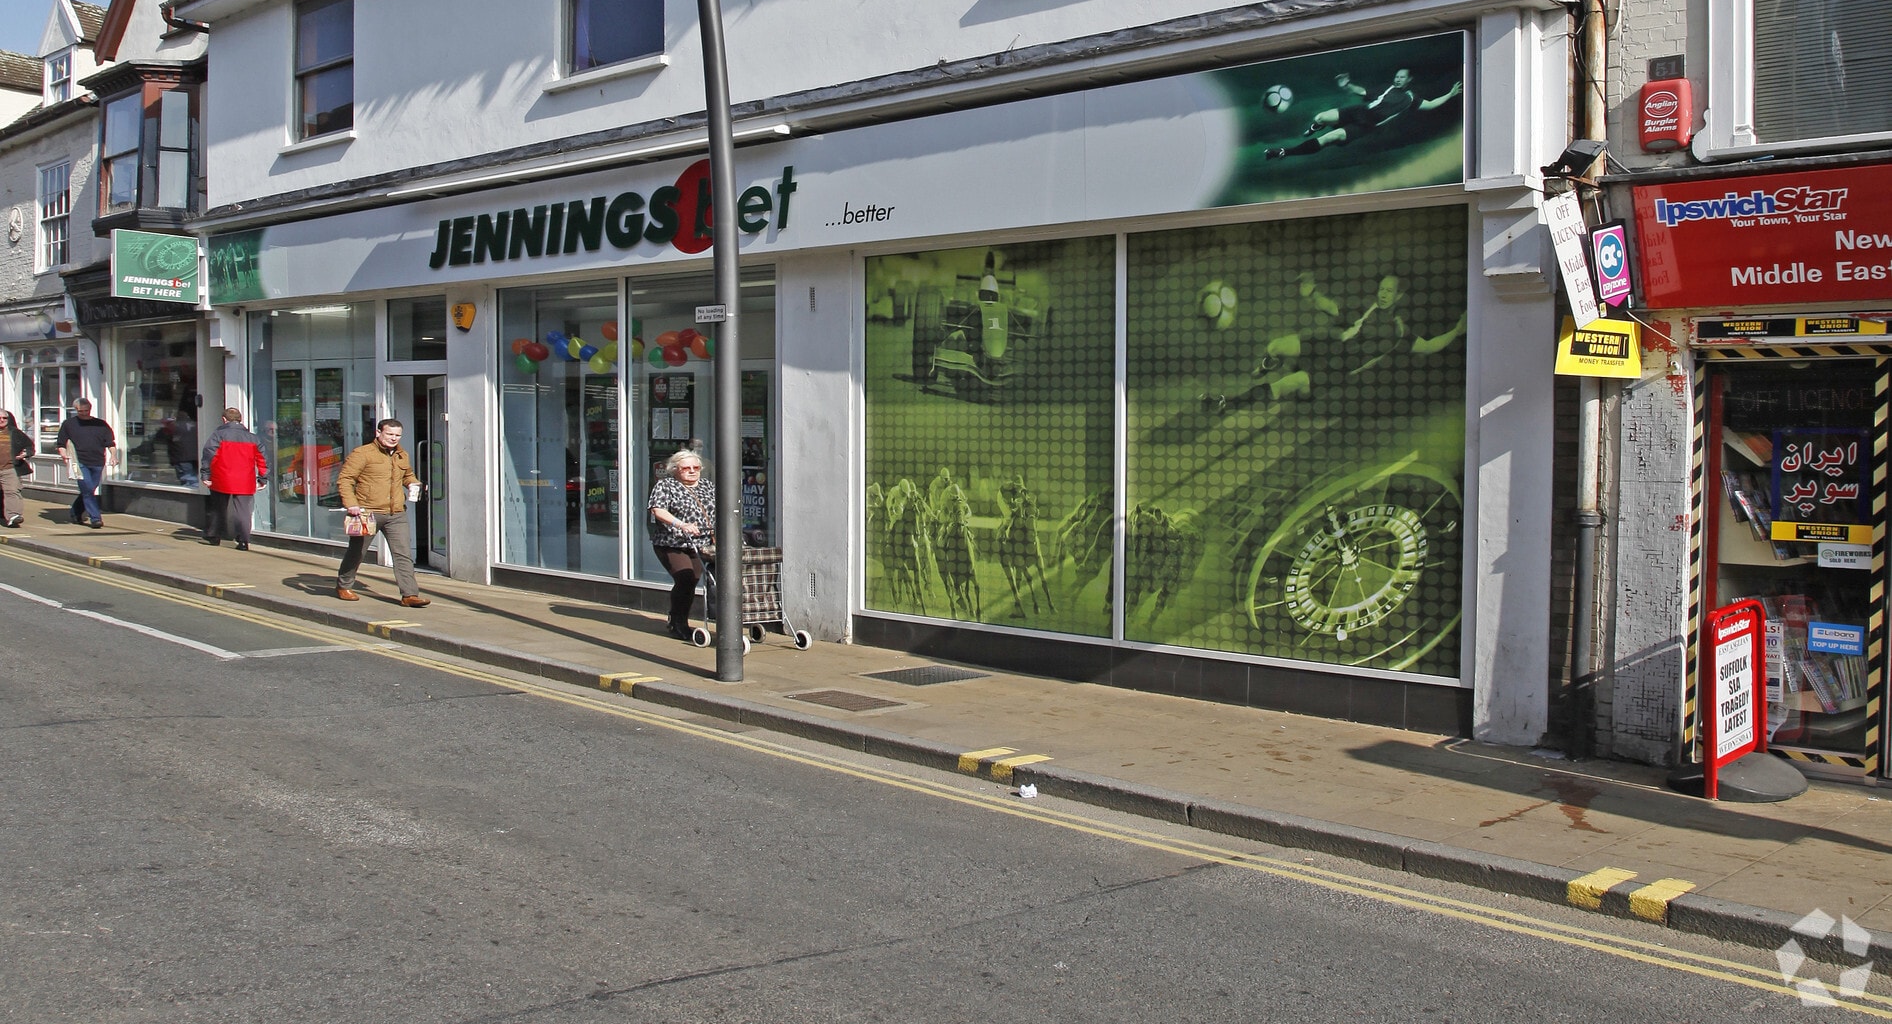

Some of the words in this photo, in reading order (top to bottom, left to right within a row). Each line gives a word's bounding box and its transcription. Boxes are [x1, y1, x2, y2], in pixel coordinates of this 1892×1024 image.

[1655, 61, 1676, 77] 51
[1646, 100, 1677, 109] Anglian
[1644, 117, 1678, 126] Burglar
[1645, 125, 1677, 133] Alarms
[1556, 203, 1570, 220] OFF
[1730, 219, 1755, 228] Your
[1758, 216, 1791, 226] Town,
[1794, 214, 1820, 224] Your
[1823, 211, 1847, 222] Star
[1552, 221, 1585, 246] LICENCE
[1731, 262, 1823, 286] Middle
[132, 286, 152, 295] BET
[154, 288, 182, 297] HERE
[1574, 277, 1591, 293] East
[1603, 277, 1627, 296] payzone
[1575, 332, 1620, 345] WESTERN
[1588, 344, 1619, 355] UNION
[586, 405, 602, 416] JOIN
[1781, 441, 1857, 477] ایران
[587, 487, 605, 497] JOIN
[743, 485, 765, 495] LAY
[742, 495, 765, 506] INGO
[743, 507, 765, 517] ERE!
[1824, 630, 1855, 638] Lebara
[1720, 655, 1748, 681] SUFFOLK
[1720, 689, 1750, 717] TRAGEDY
[1724, 709, 1747, 734] LATEST
